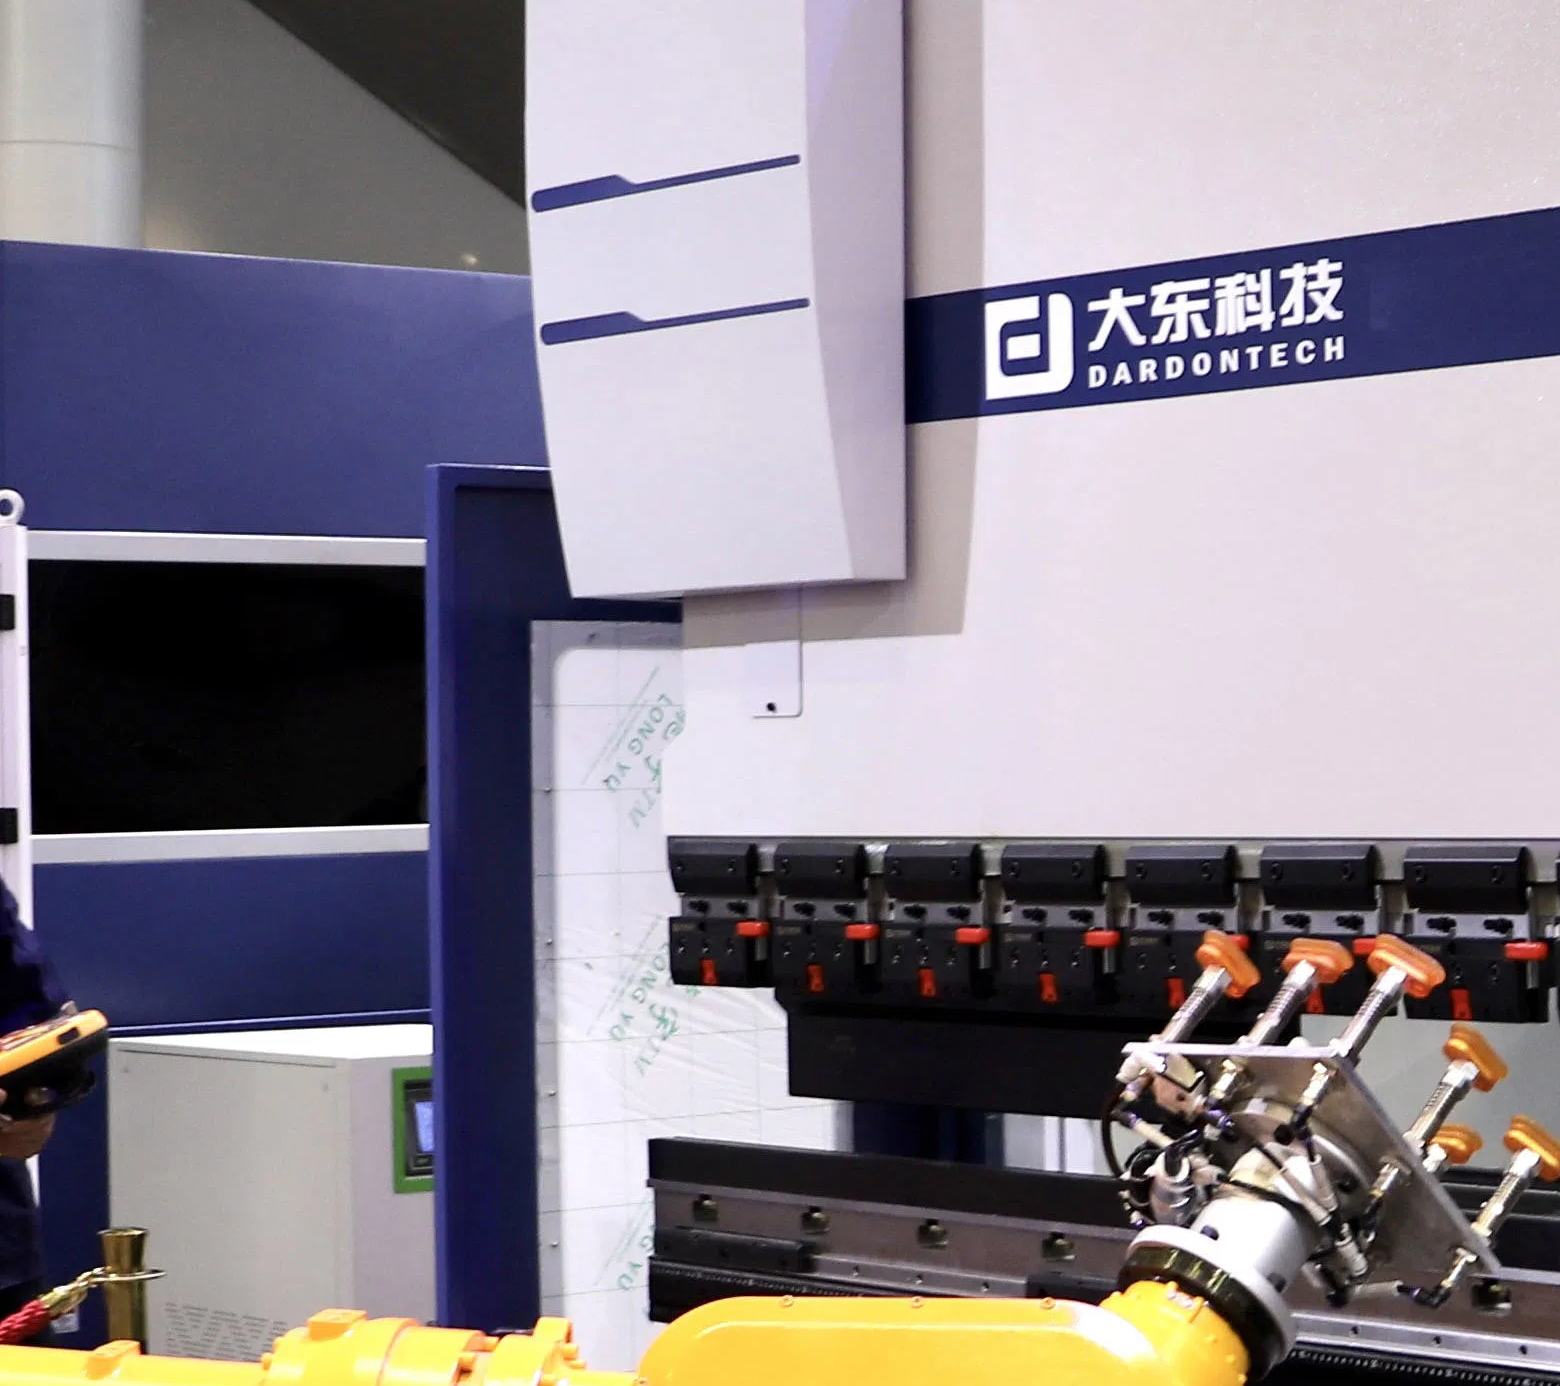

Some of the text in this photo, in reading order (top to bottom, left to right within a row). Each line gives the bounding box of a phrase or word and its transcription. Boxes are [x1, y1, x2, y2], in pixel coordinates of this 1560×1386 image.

[1087, 258, 1344, 352] 大东科技
[1088, 335, 1346, 389] DARDONTECH
